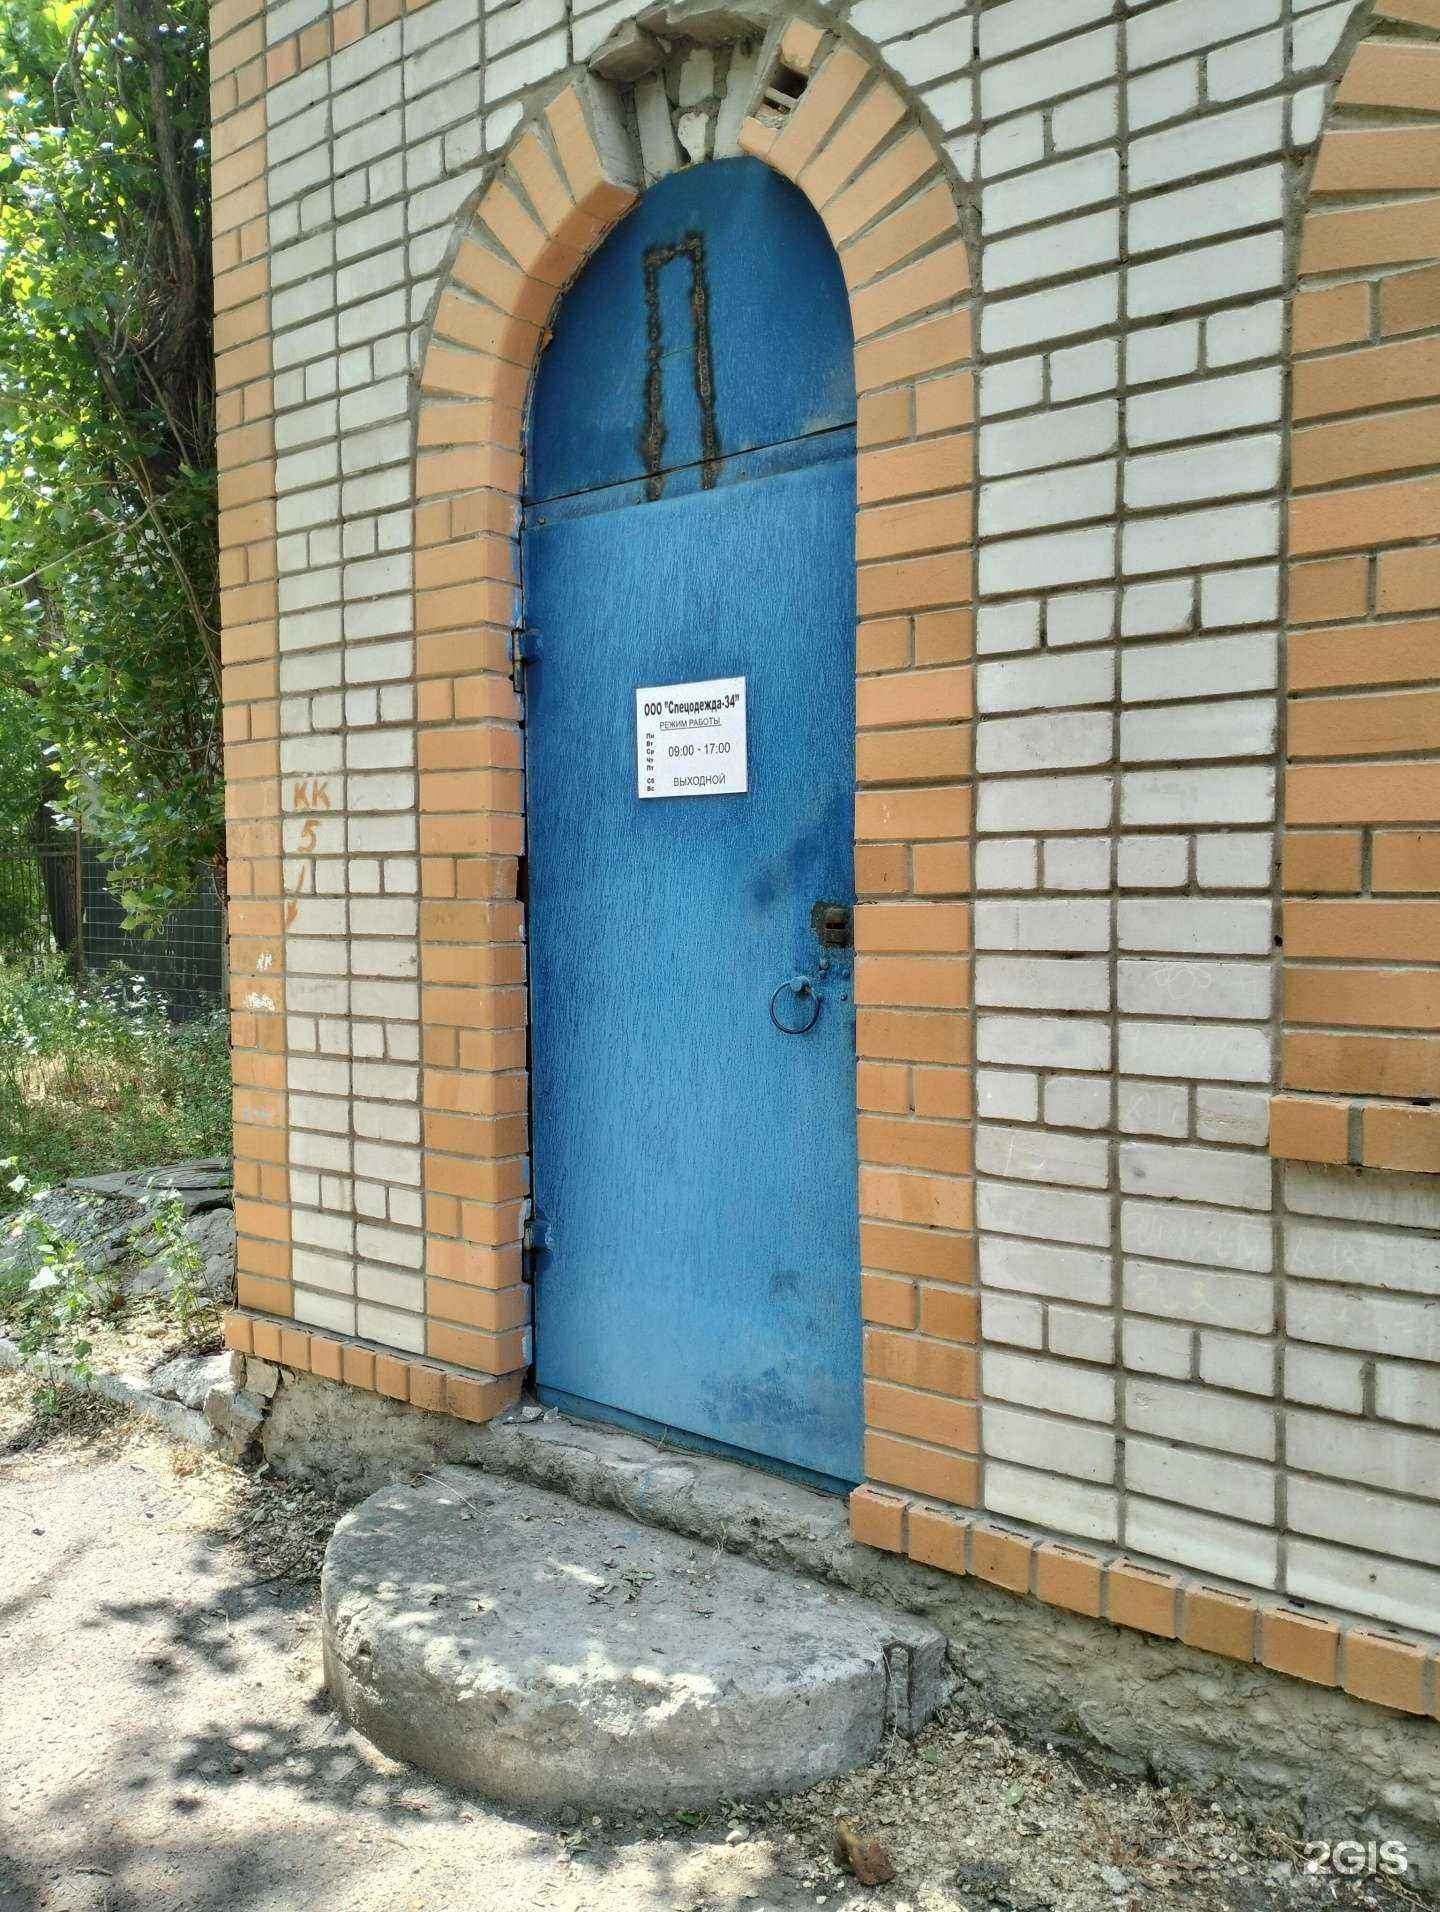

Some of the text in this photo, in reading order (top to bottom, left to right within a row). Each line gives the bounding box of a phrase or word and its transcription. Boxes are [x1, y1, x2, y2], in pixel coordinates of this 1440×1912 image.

[644, 694, 740, 716] ООО "Спецодежда-34"
[660, 717, 720, 729] РЕЖИМ РАБОТЫ
[668, 745, 694, 757] 09:00
[704, 742, 731, 754] 17:00
[673, 773, 726, 787] ВЫХОДНОЙ
[296, 819, 322, 853] 5
